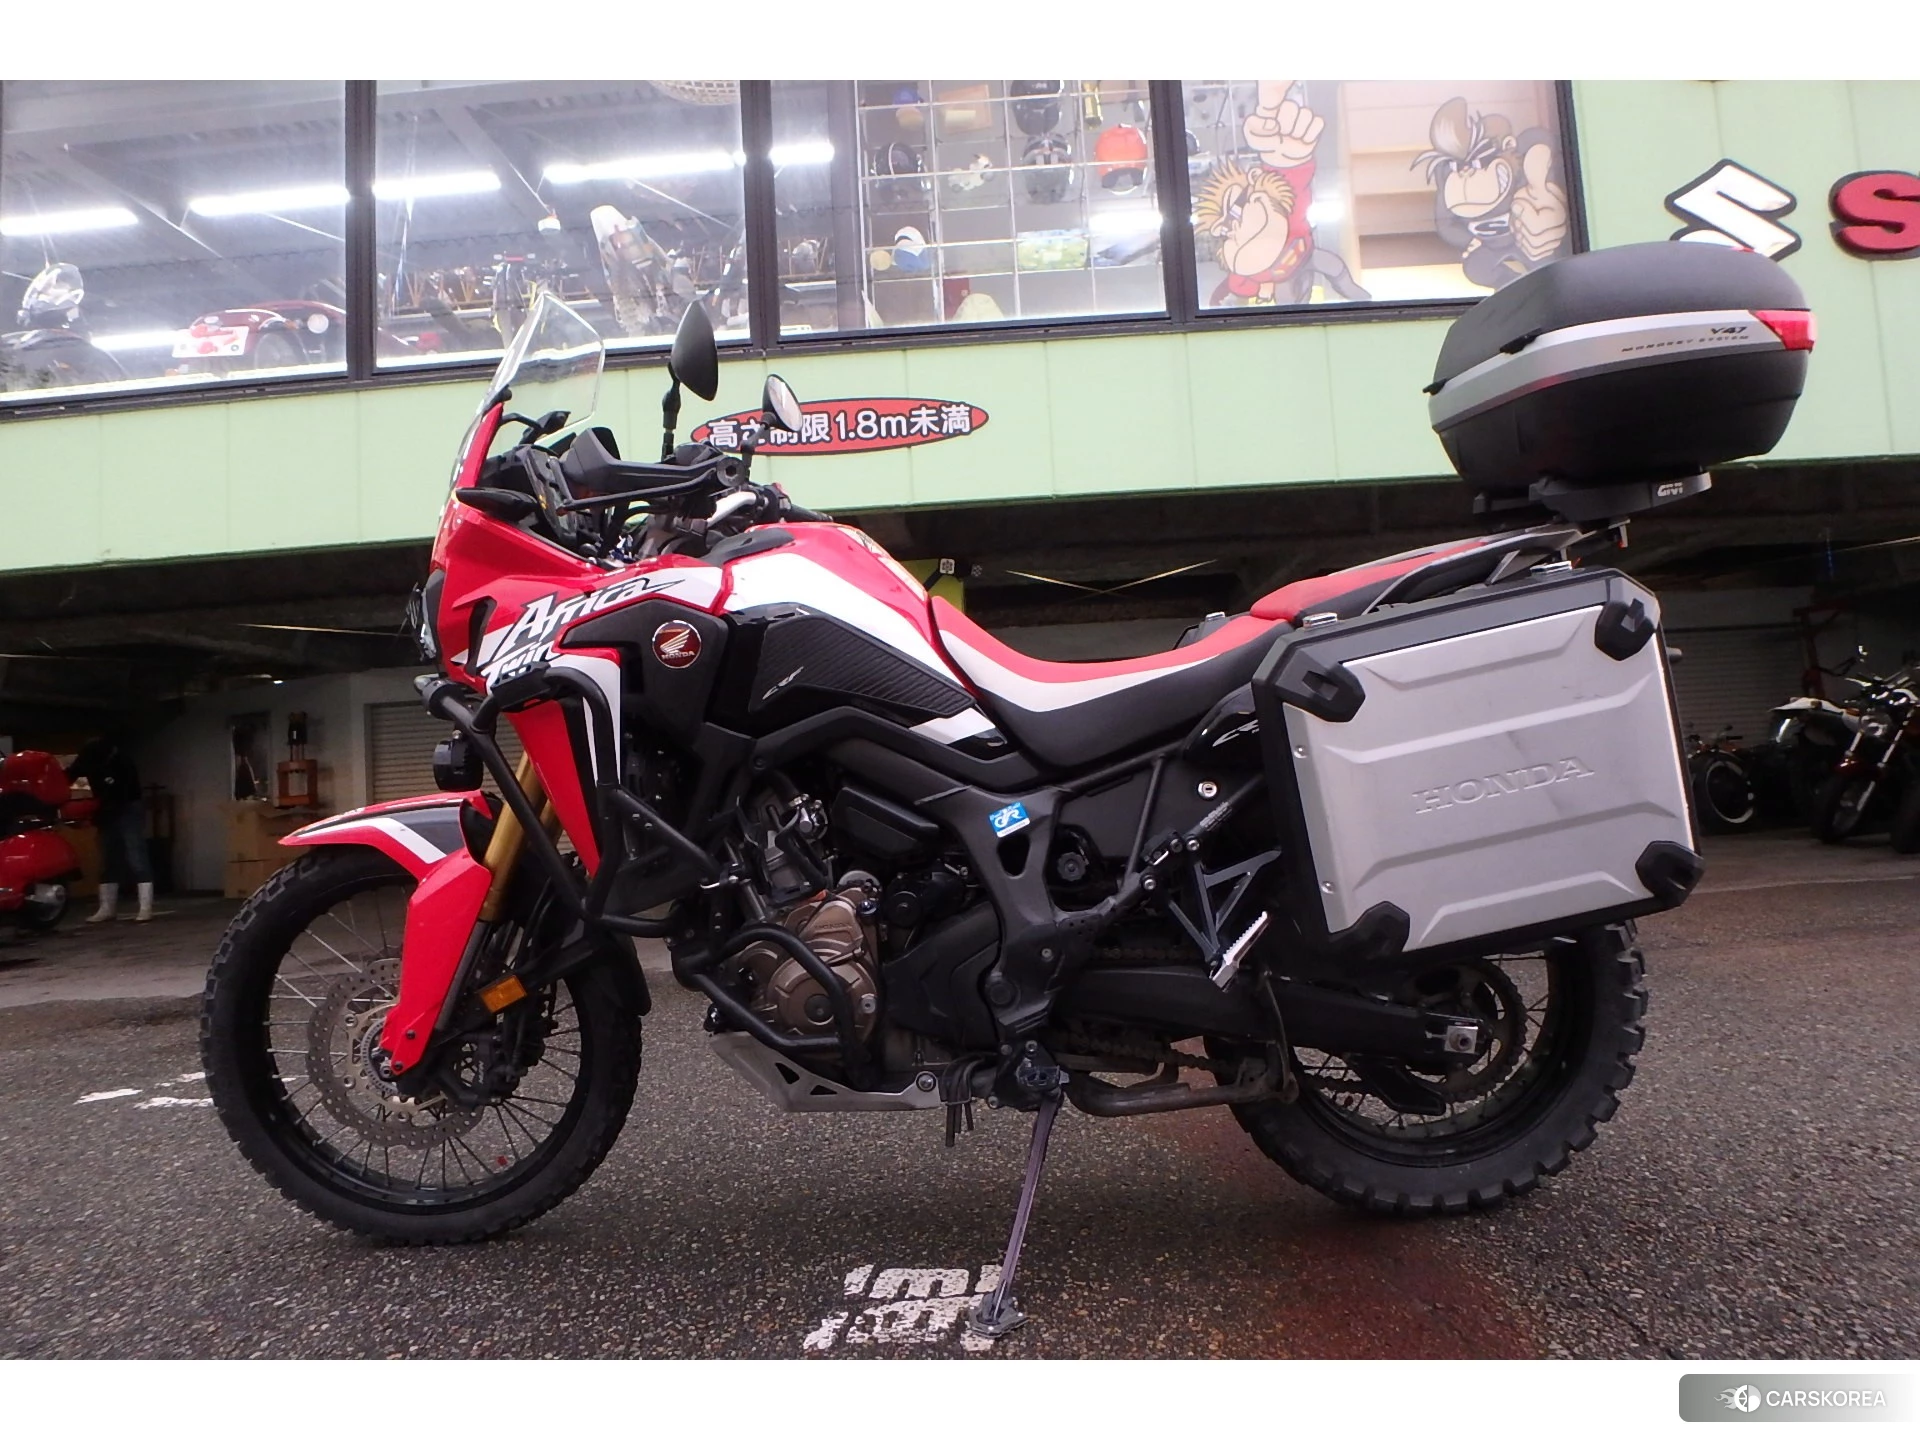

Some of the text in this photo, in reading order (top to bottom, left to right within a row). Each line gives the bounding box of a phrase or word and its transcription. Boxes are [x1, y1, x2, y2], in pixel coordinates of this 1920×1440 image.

[1711, 326, 1747, 335] V47
[1657, 482, 1684, 497] GIVI
[493, 577, 686, 662] Africa
[660, 650, 696, 660] HONDA
[1411, 756, 1596, 815] HONDA
